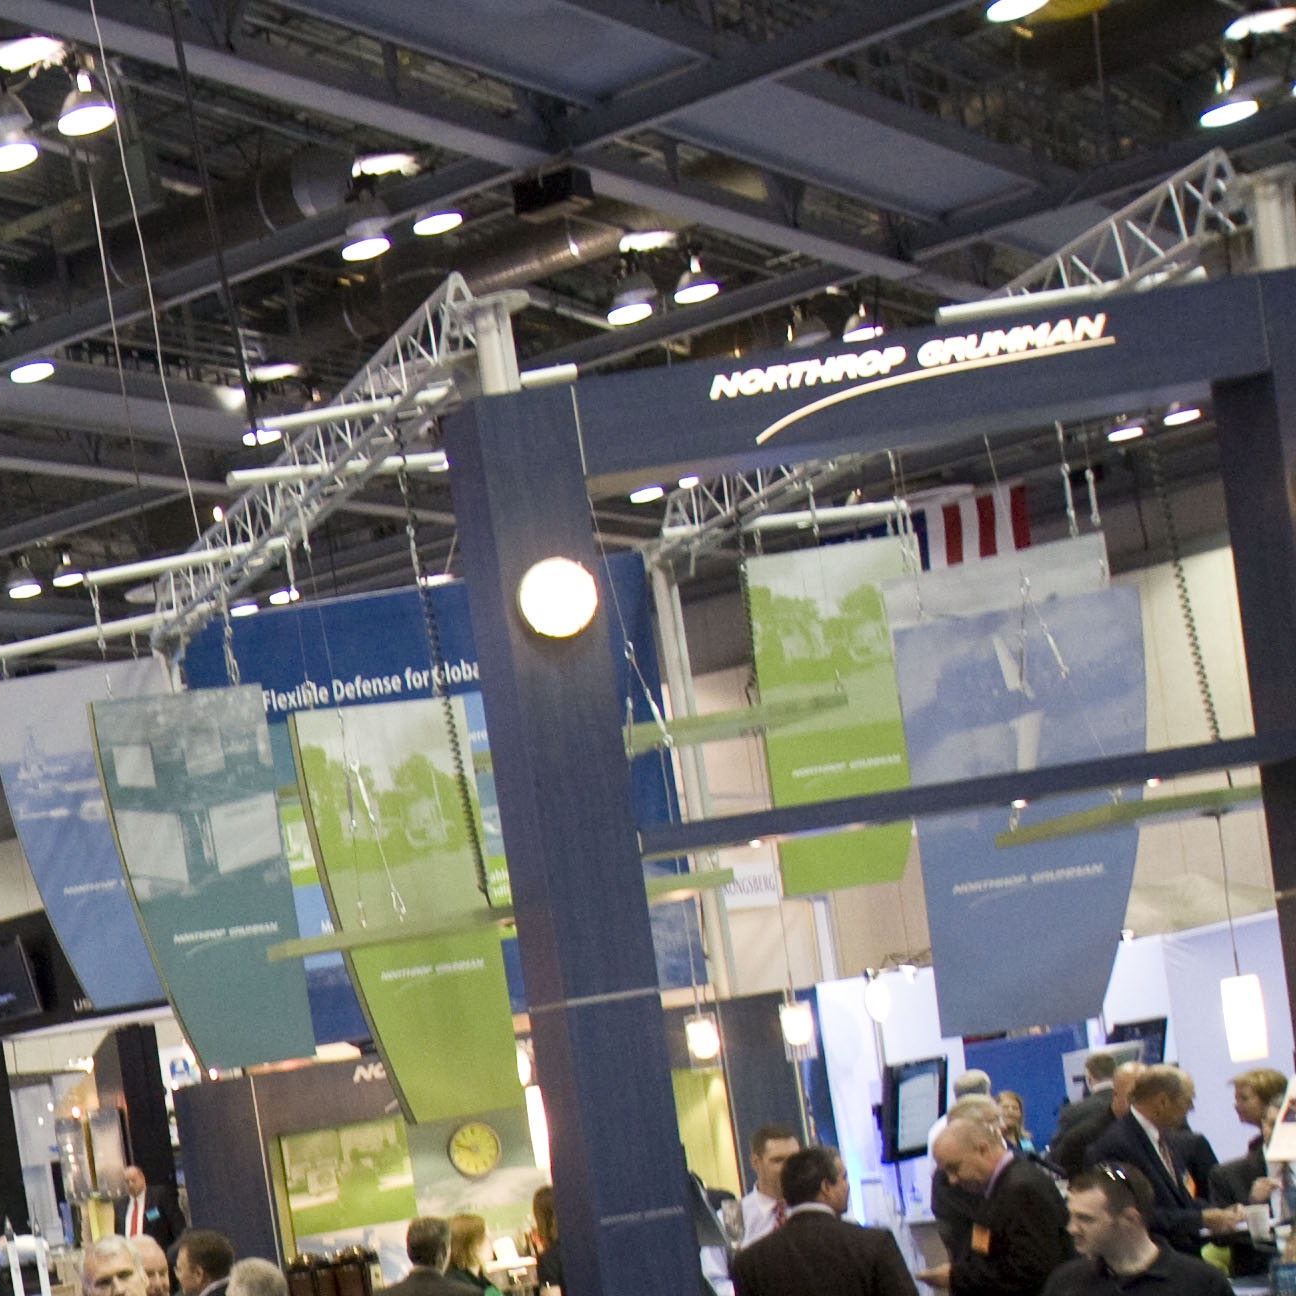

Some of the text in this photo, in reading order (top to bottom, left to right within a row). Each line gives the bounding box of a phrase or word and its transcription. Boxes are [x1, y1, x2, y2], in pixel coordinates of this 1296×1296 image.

[709, 312, 1107, 400] NORTHROP GRUMMAN
[262, 678, 329, 712] Flexible
[332, 673, 403, 703] Defense
[404, 665, 429, 691] for
